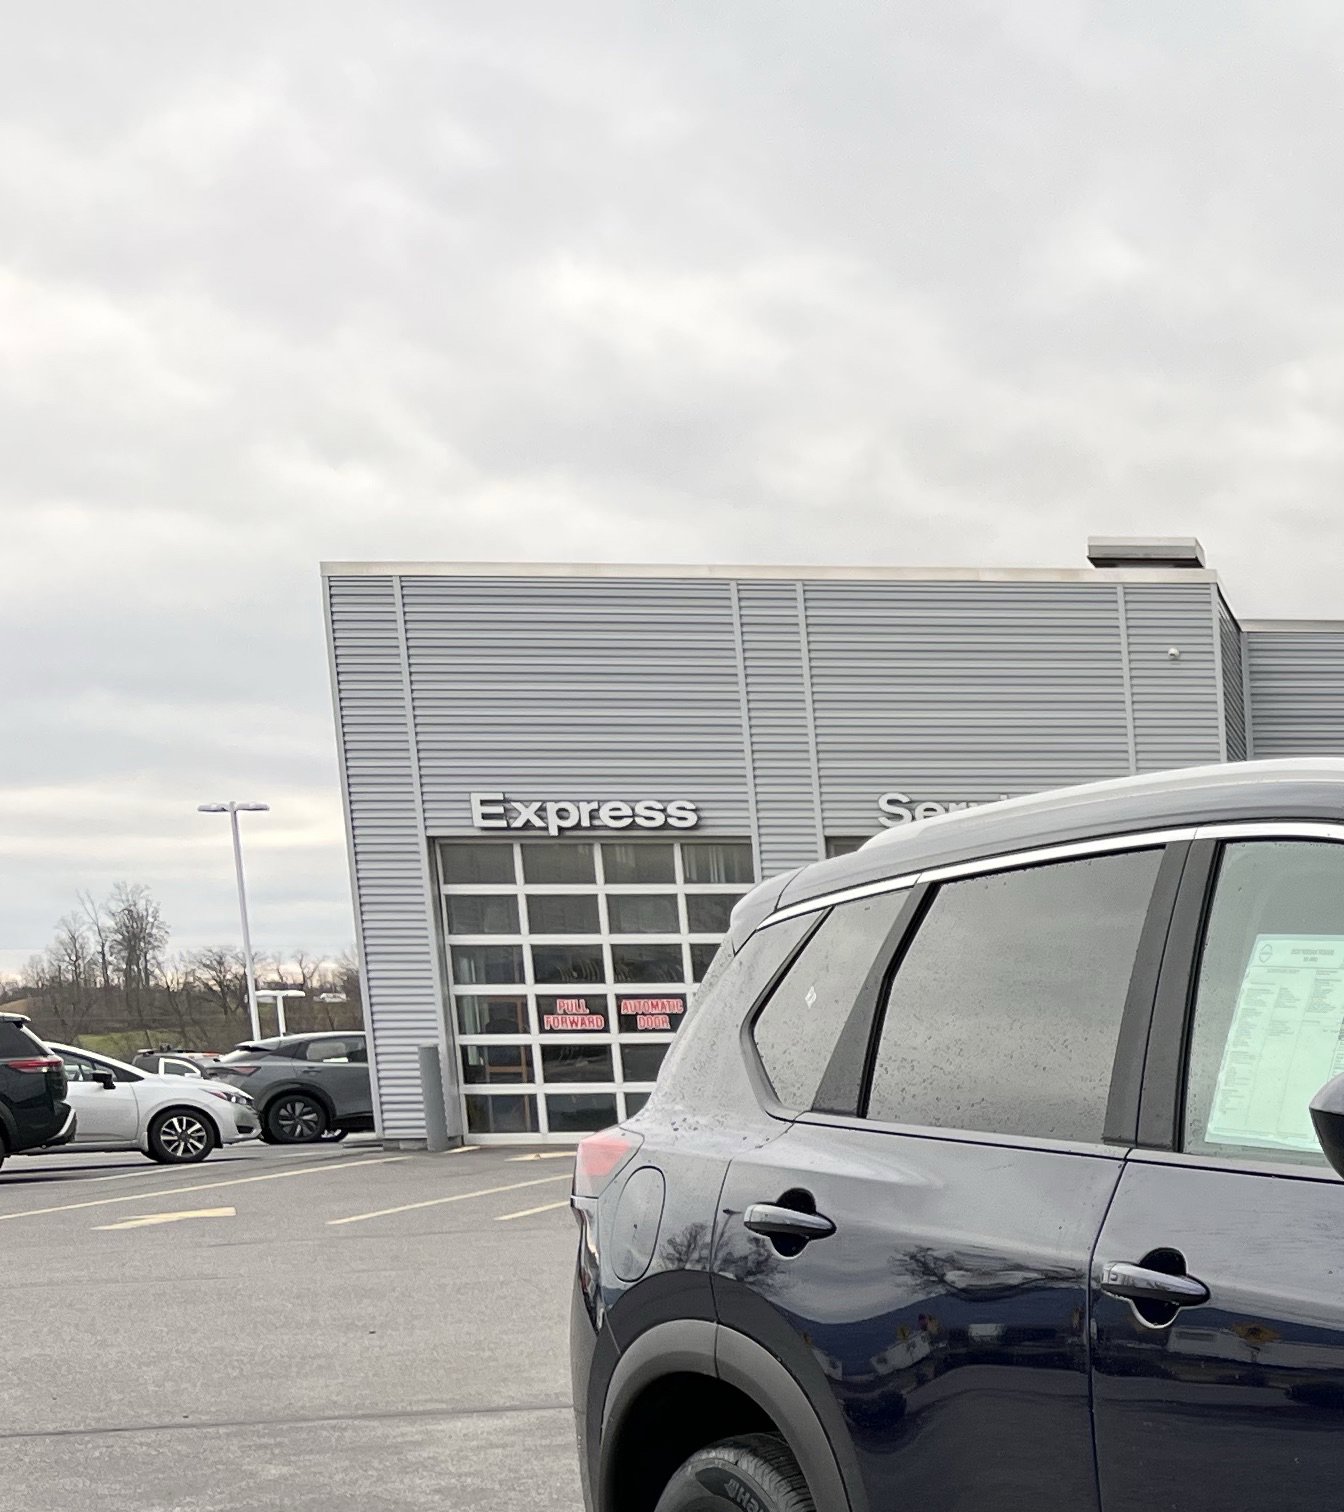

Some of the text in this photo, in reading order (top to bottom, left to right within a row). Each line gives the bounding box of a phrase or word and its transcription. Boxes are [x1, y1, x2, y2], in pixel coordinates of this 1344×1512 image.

[470, 792, 699, 837] Express
[555, 999, 590, 1014] PULL
[620, 999, 684, 1014] AUTOMATIC
[543, 1014, 605, 1030] FORWARD
[636, 1014, 671, 1030] DOOR
